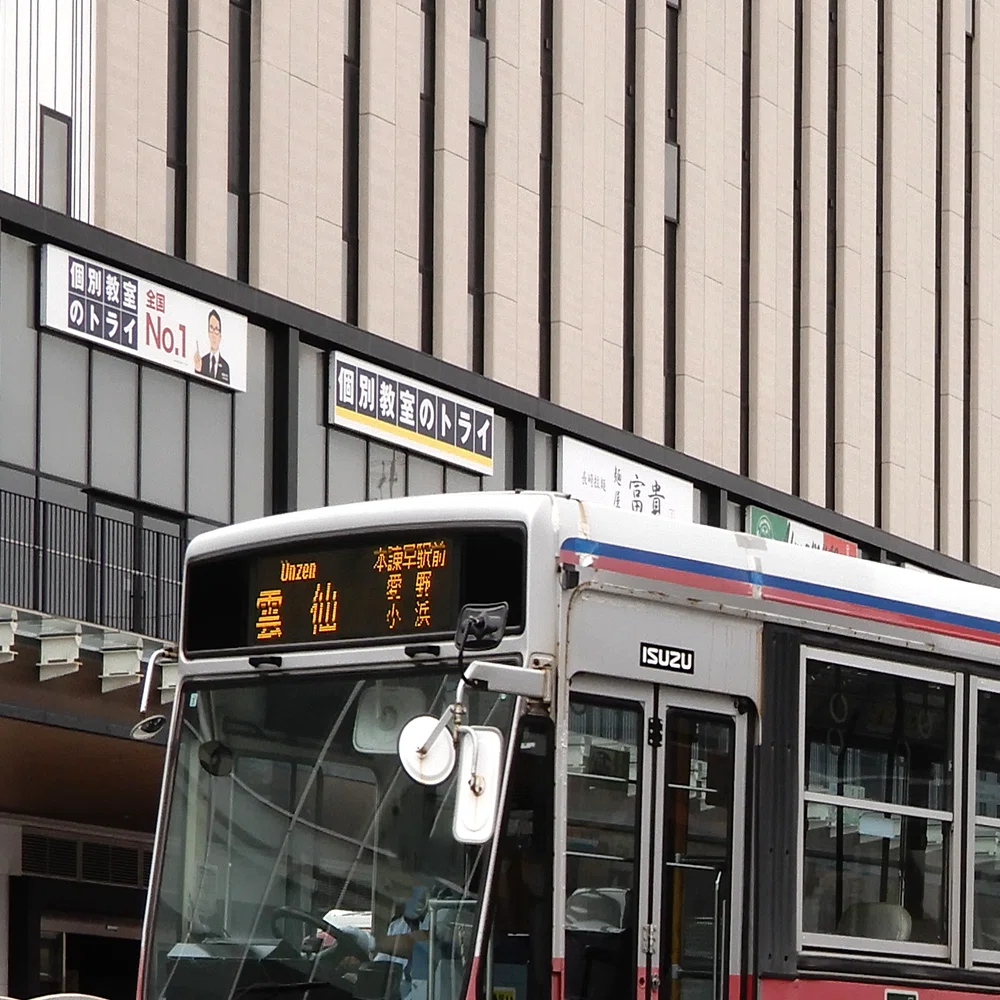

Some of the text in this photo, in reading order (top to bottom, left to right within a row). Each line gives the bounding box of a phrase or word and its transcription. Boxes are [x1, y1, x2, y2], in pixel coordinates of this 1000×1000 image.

[70, 261, 137, 310] 個別教室
[146, 289, 165, 313] 全国
[70, 300, 136, 344] のトライ
[146, 312, 186, 358] No.1
[338, 367, 490, 451] 個別教室のトライ
[629, 474, 665, 515] 富貴
[280, 562, 317, 581] Unzen
[256, 582, 338, 640] 雲仙
[642, 646, 692, 670] ISUZU
